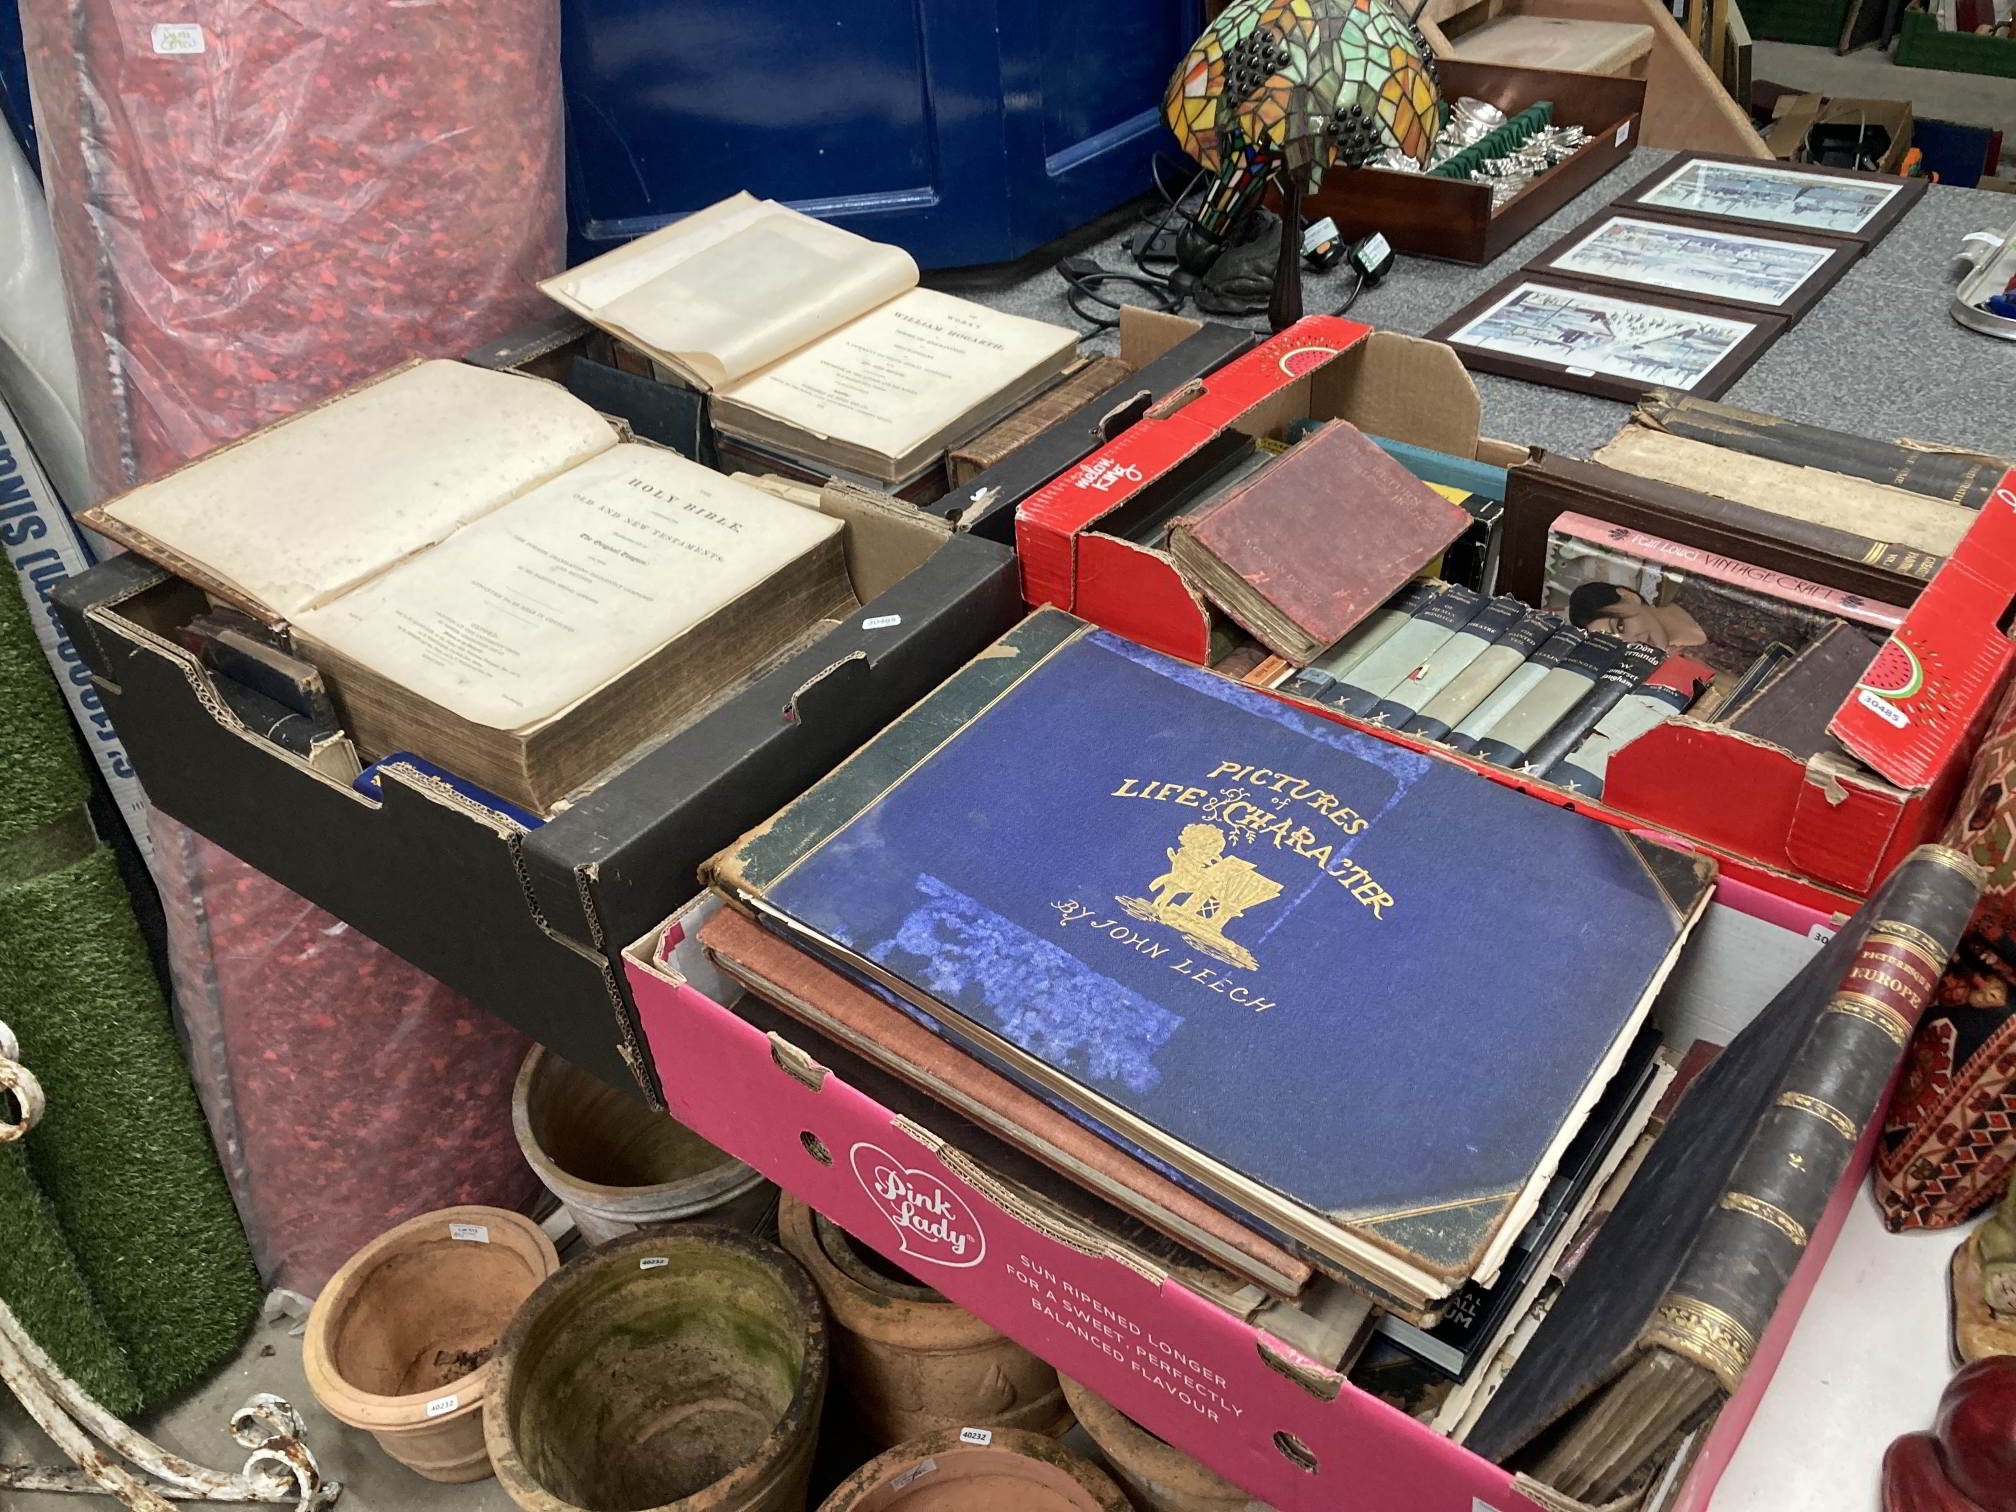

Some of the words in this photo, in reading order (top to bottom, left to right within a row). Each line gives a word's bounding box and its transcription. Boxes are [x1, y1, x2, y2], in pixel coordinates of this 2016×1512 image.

[572, 493, 595, 507] OLD
[599, 504, 622, 519] AND
[624, 516, 650, 531] NEW
[628, 477, 680, 504] HOLY
[1703, 552, 1776, 584] VINTAGE
[1863, 695, 1900, 722] 30485
[1206, 760, 1370, 835] PICTURES
[1271, 796, 1291, 811] of
[1110, 778, 1208, 807] LIFE
[1222, 801, 1395, 921] CHARACTER
[1050, 898, 1096, 927] BY
[1090, 919, 1170, 959] JOHN
[1169, 958, 1277, 1012] LEECH
[1850, 967, 1922, 1010] EUROPE
[874, 1165, 956, 1221] Pink
[890, 1200, 966, 1255] Lady
[1006, 1263, 1040, 1292] FOR
[1046, 1290, 1057, 1303] A
[1135, 1345, 1244, 1417] PERFECTLY
[1019, 1254, 1057, 1284] SUN
[1062, 1281, 1141, 1336] RIPENED
[1148, 1333, 1227, 1389] LONGER
[1031, 1297, 1124, 1363] BALANCED
[1131, 1360, 1220, 1424] FLAVOUR
[962, 1430, 987, 1441] 40232
